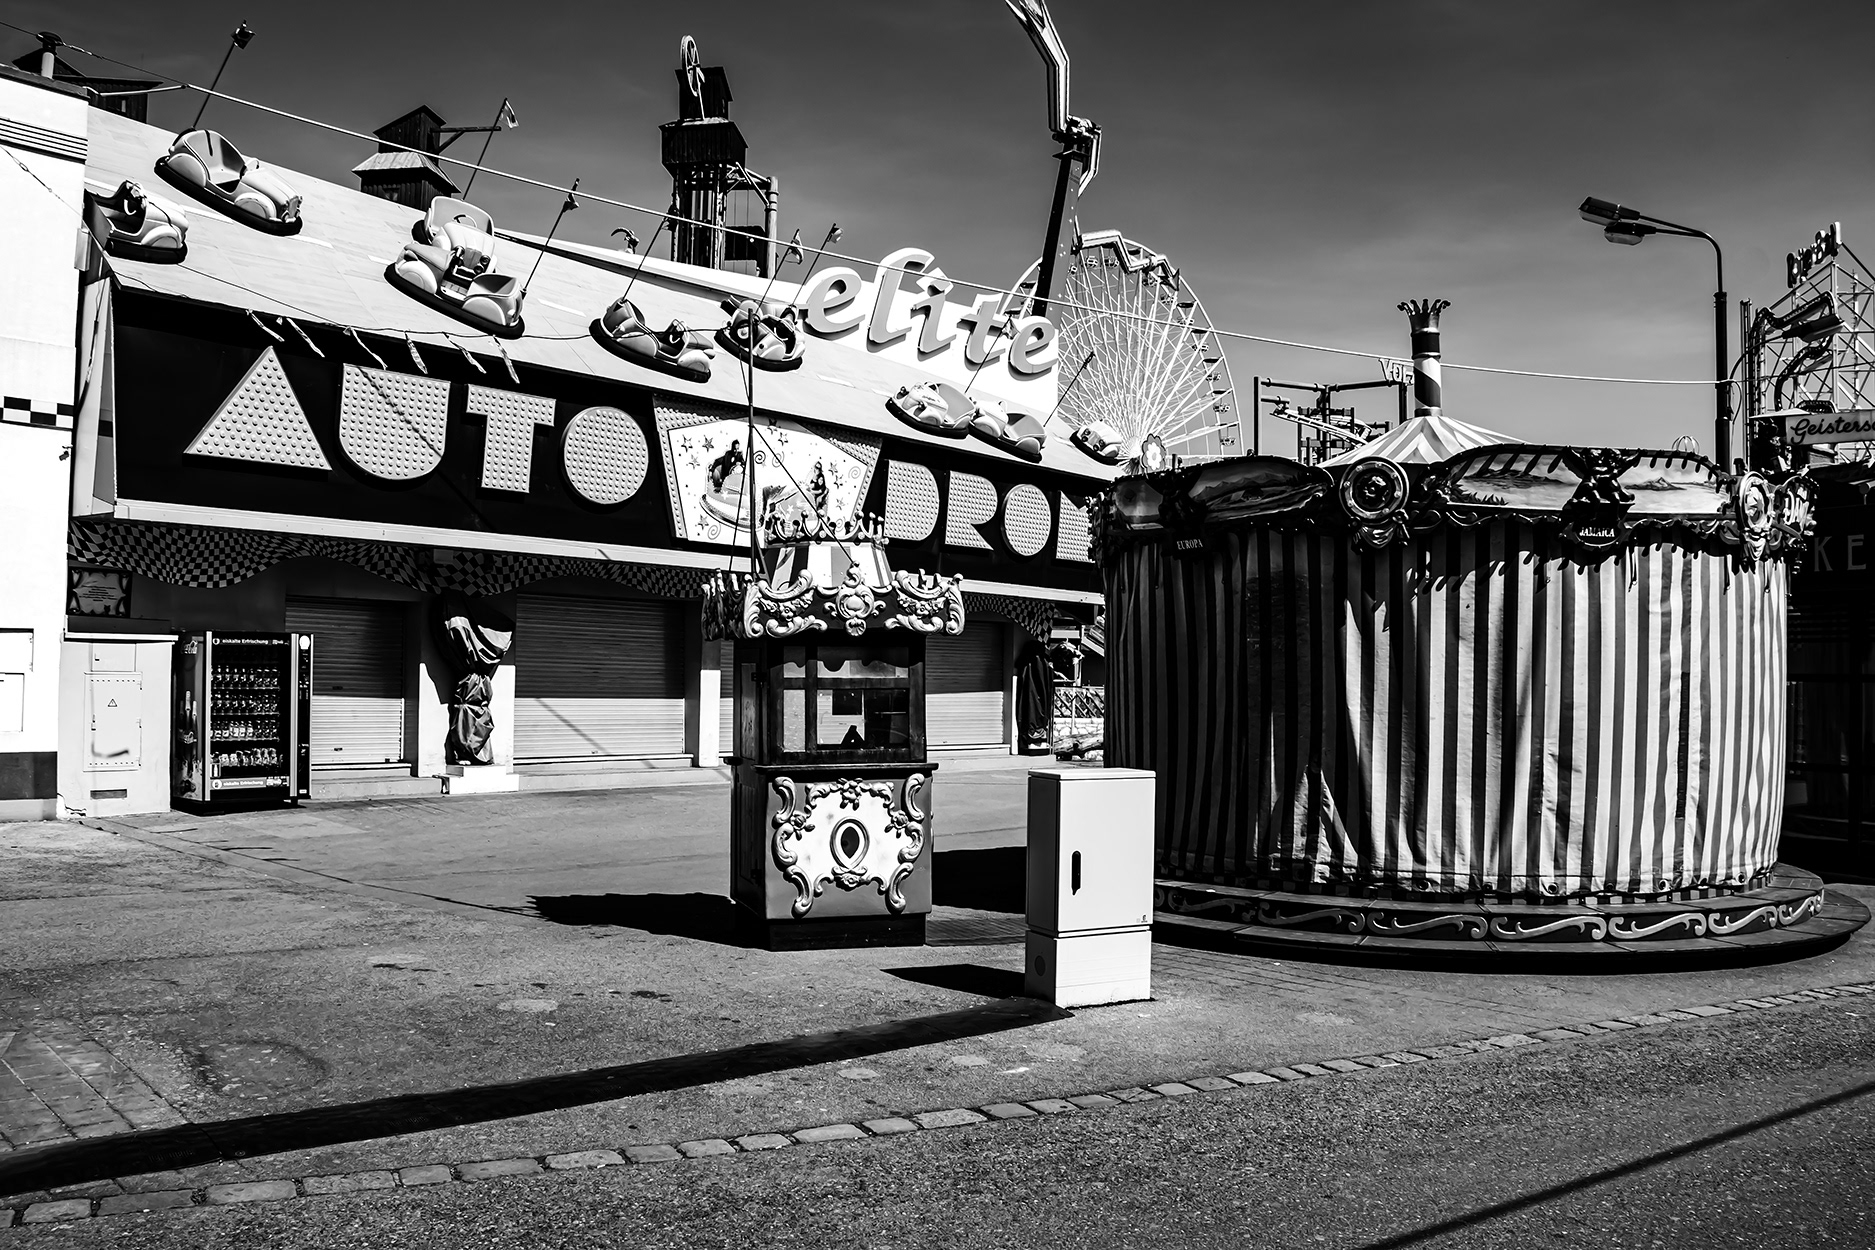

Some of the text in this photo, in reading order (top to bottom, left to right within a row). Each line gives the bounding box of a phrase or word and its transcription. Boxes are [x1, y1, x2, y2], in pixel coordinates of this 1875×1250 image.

[803, 247, 1060, 382] elite
[1377, 358, 1415, 386] VOL
[183, 344, 1096, 565] AUTO DROM
[1177, 539, 1203, 549] EUROPA
[1579, 526, 1615, 538] JAMAICA
